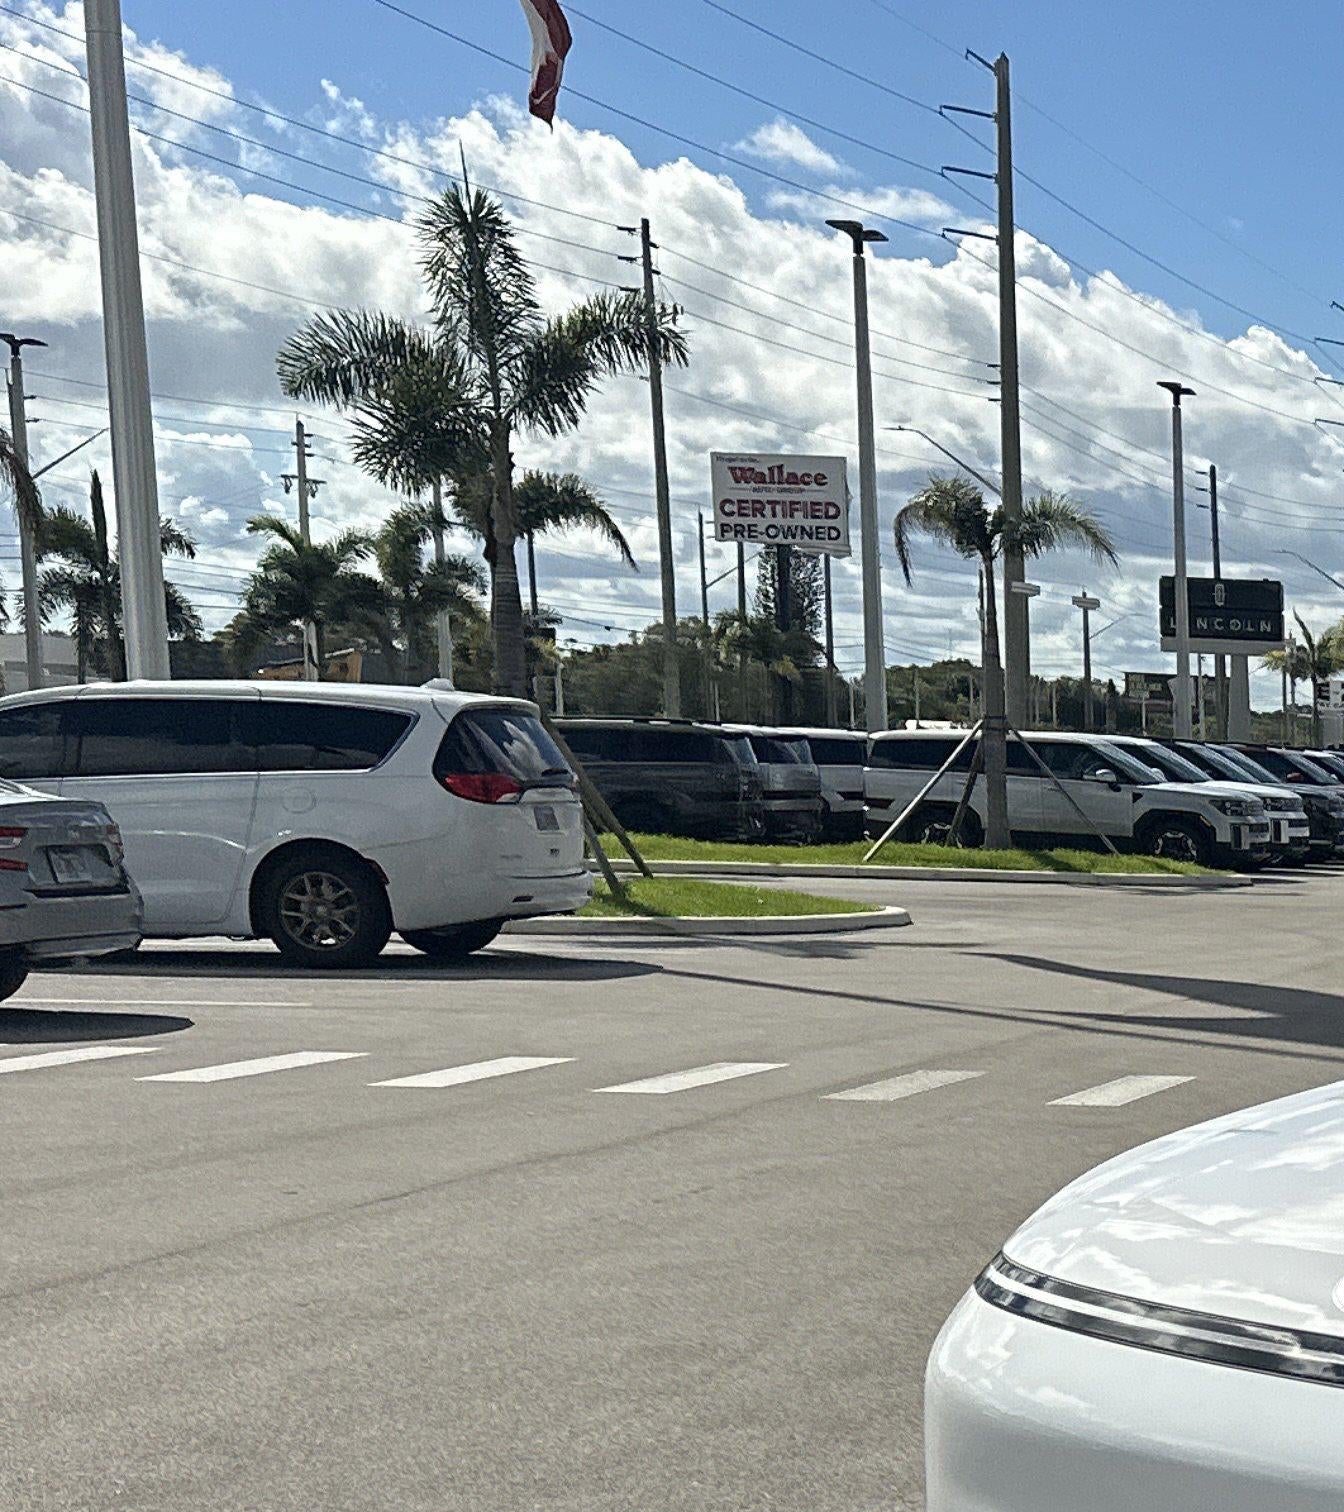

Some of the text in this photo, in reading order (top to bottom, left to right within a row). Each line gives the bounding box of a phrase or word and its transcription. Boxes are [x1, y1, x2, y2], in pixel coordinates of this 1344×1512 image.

[727, 464, 828, 487] Wallace
[719, 498, 841, 520] CERTIFIED
[719, 523, 841, 541] PRE-OWNED
[1170, 617, 1272, 632] LNCOLN
